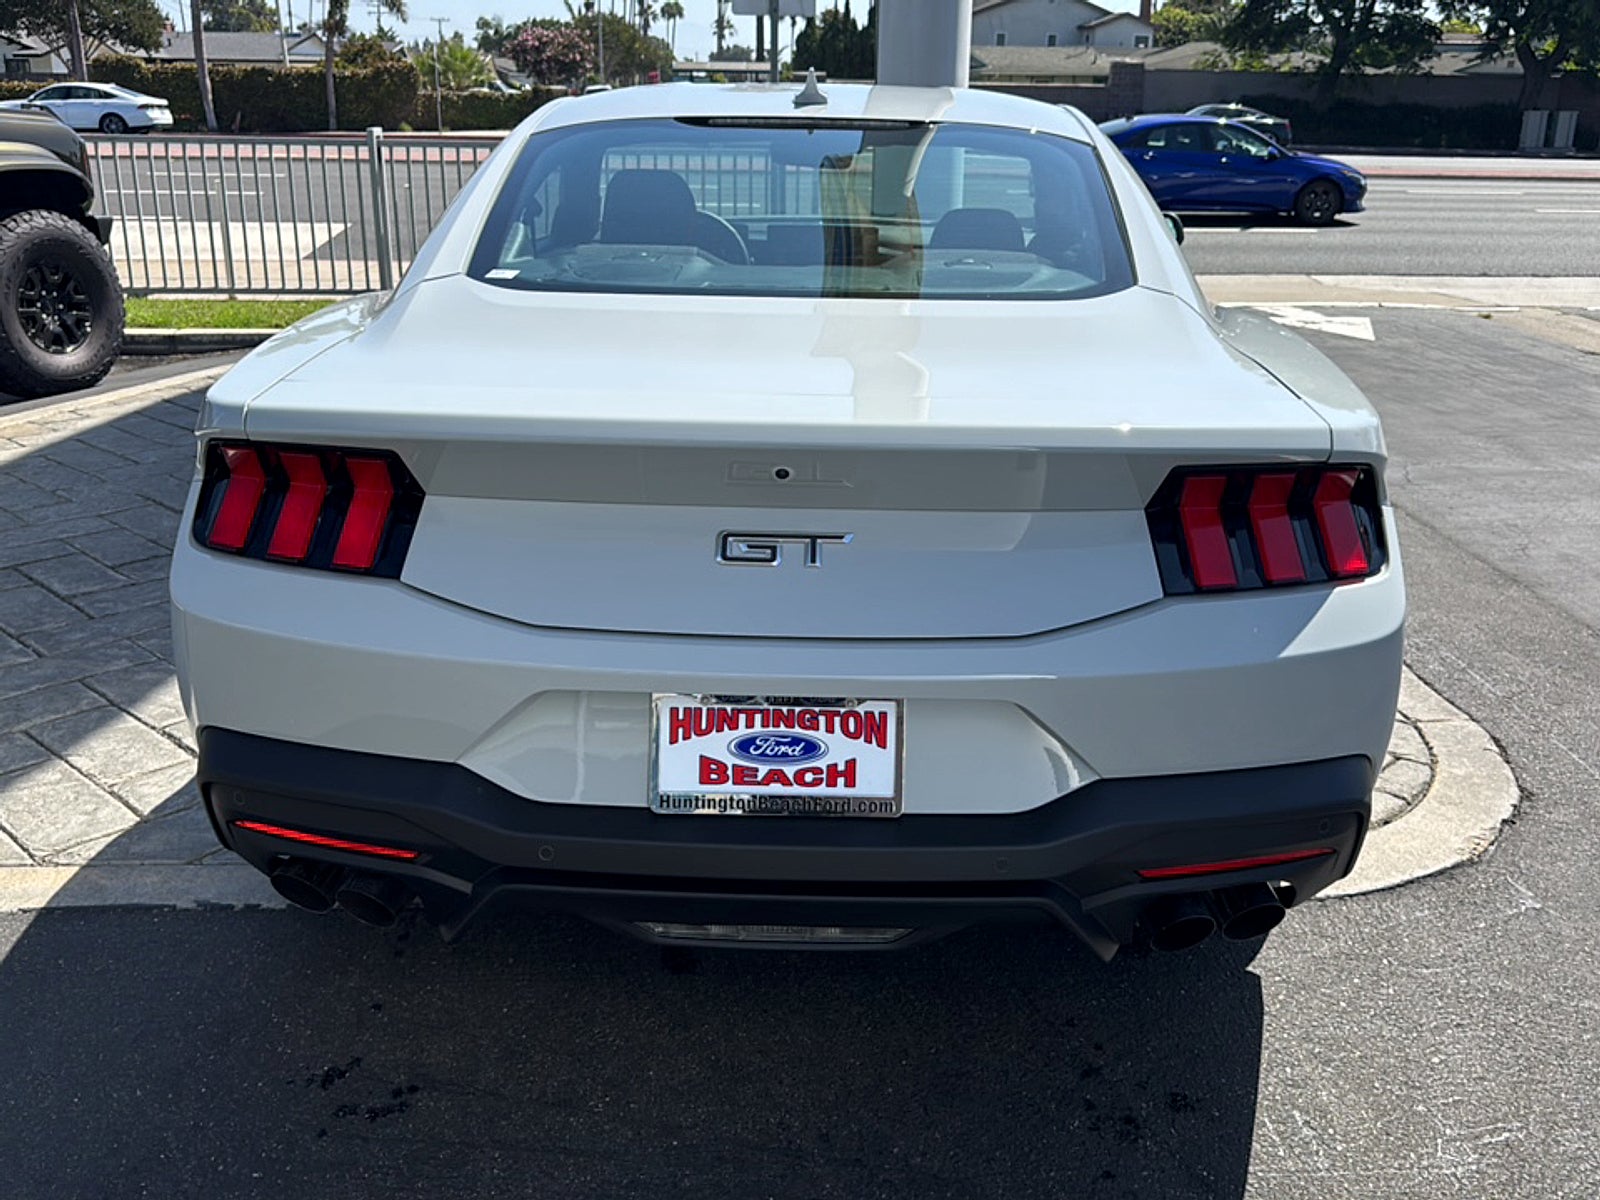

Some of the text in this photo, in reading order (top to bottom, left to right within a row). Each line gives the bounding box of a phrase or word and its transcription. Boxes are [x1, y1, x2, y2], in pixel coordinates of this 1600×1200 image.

[716, 530, 854, 568] GT
[669, 706, 888, 750] HUNTINGTON
[749, 736, 806, 758] Ford
[699, 754, 857, 789] BEACH
[658, 794, 894, 814] HuntingtonBeachFord.com
